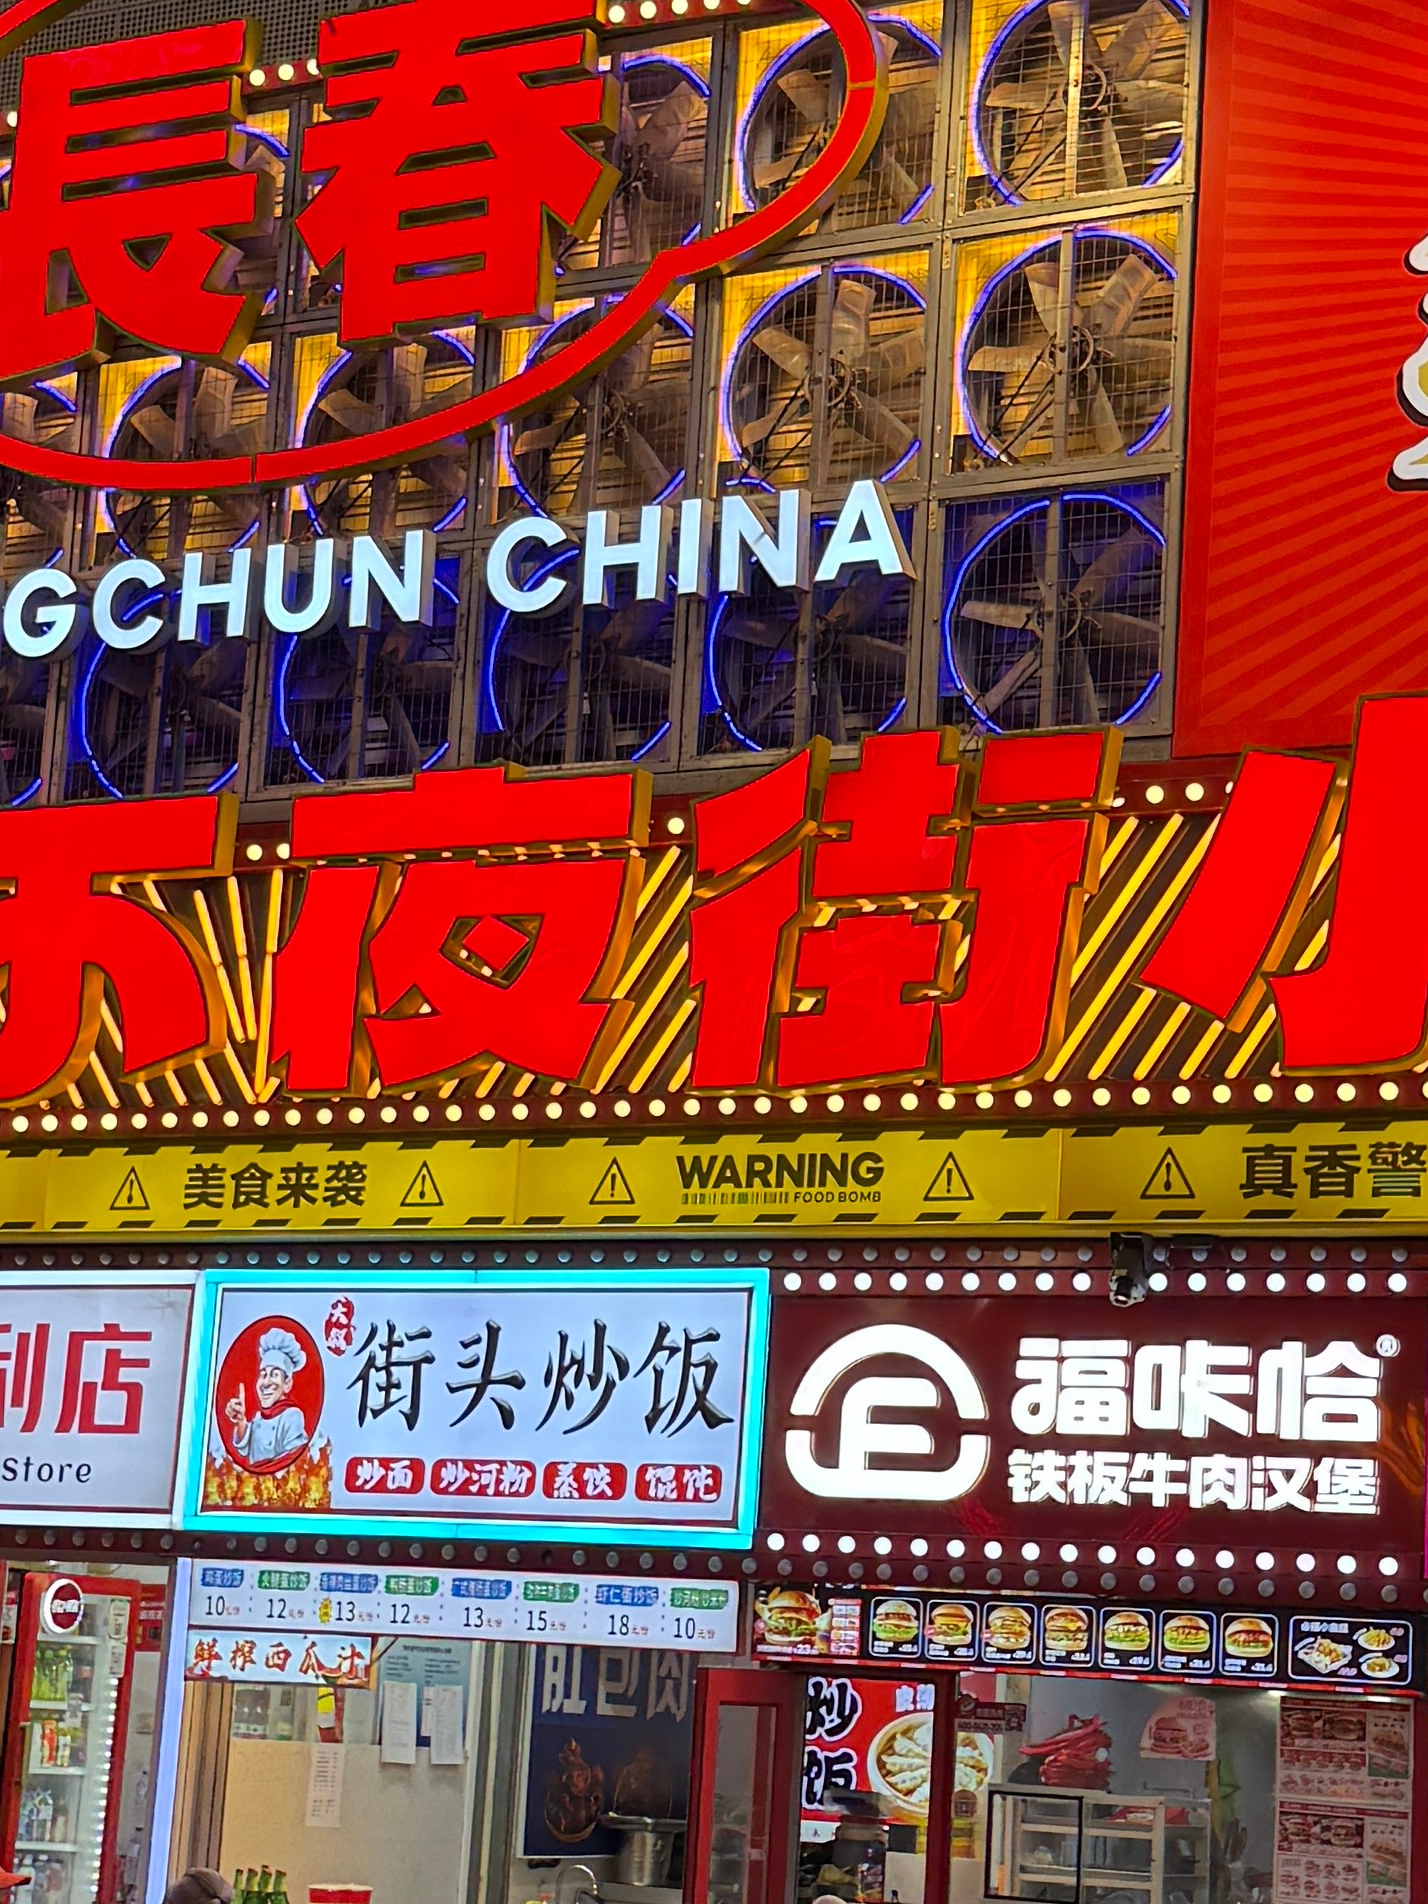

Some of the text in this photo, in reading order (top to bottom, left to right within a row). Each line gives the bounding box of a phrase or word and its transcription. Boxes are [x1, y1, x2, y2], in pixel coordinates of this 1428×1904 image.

[486, 479, 914, 612] CHINA
[183, 1160, 367, 1210] 美食来袭
[676, 1152, 884, 1189] WARNING
[794, 1191, 882, 1204] FOOD BOMB
[347, 1318, 735, 1438] 街头炒饭
[1, 1455, 92, 1484] Store
[355, 1459, 413, 1491] 炒面
[439, 1462, 533, 1497] 炒河粉
[644, 1464, 719, 1502] 馄饨
[1007, 1448, 1380, 1514] 铁板牛肉汉堡
[205, 1595, 695, 1639] 10 12 13 12 13 15 18 10
